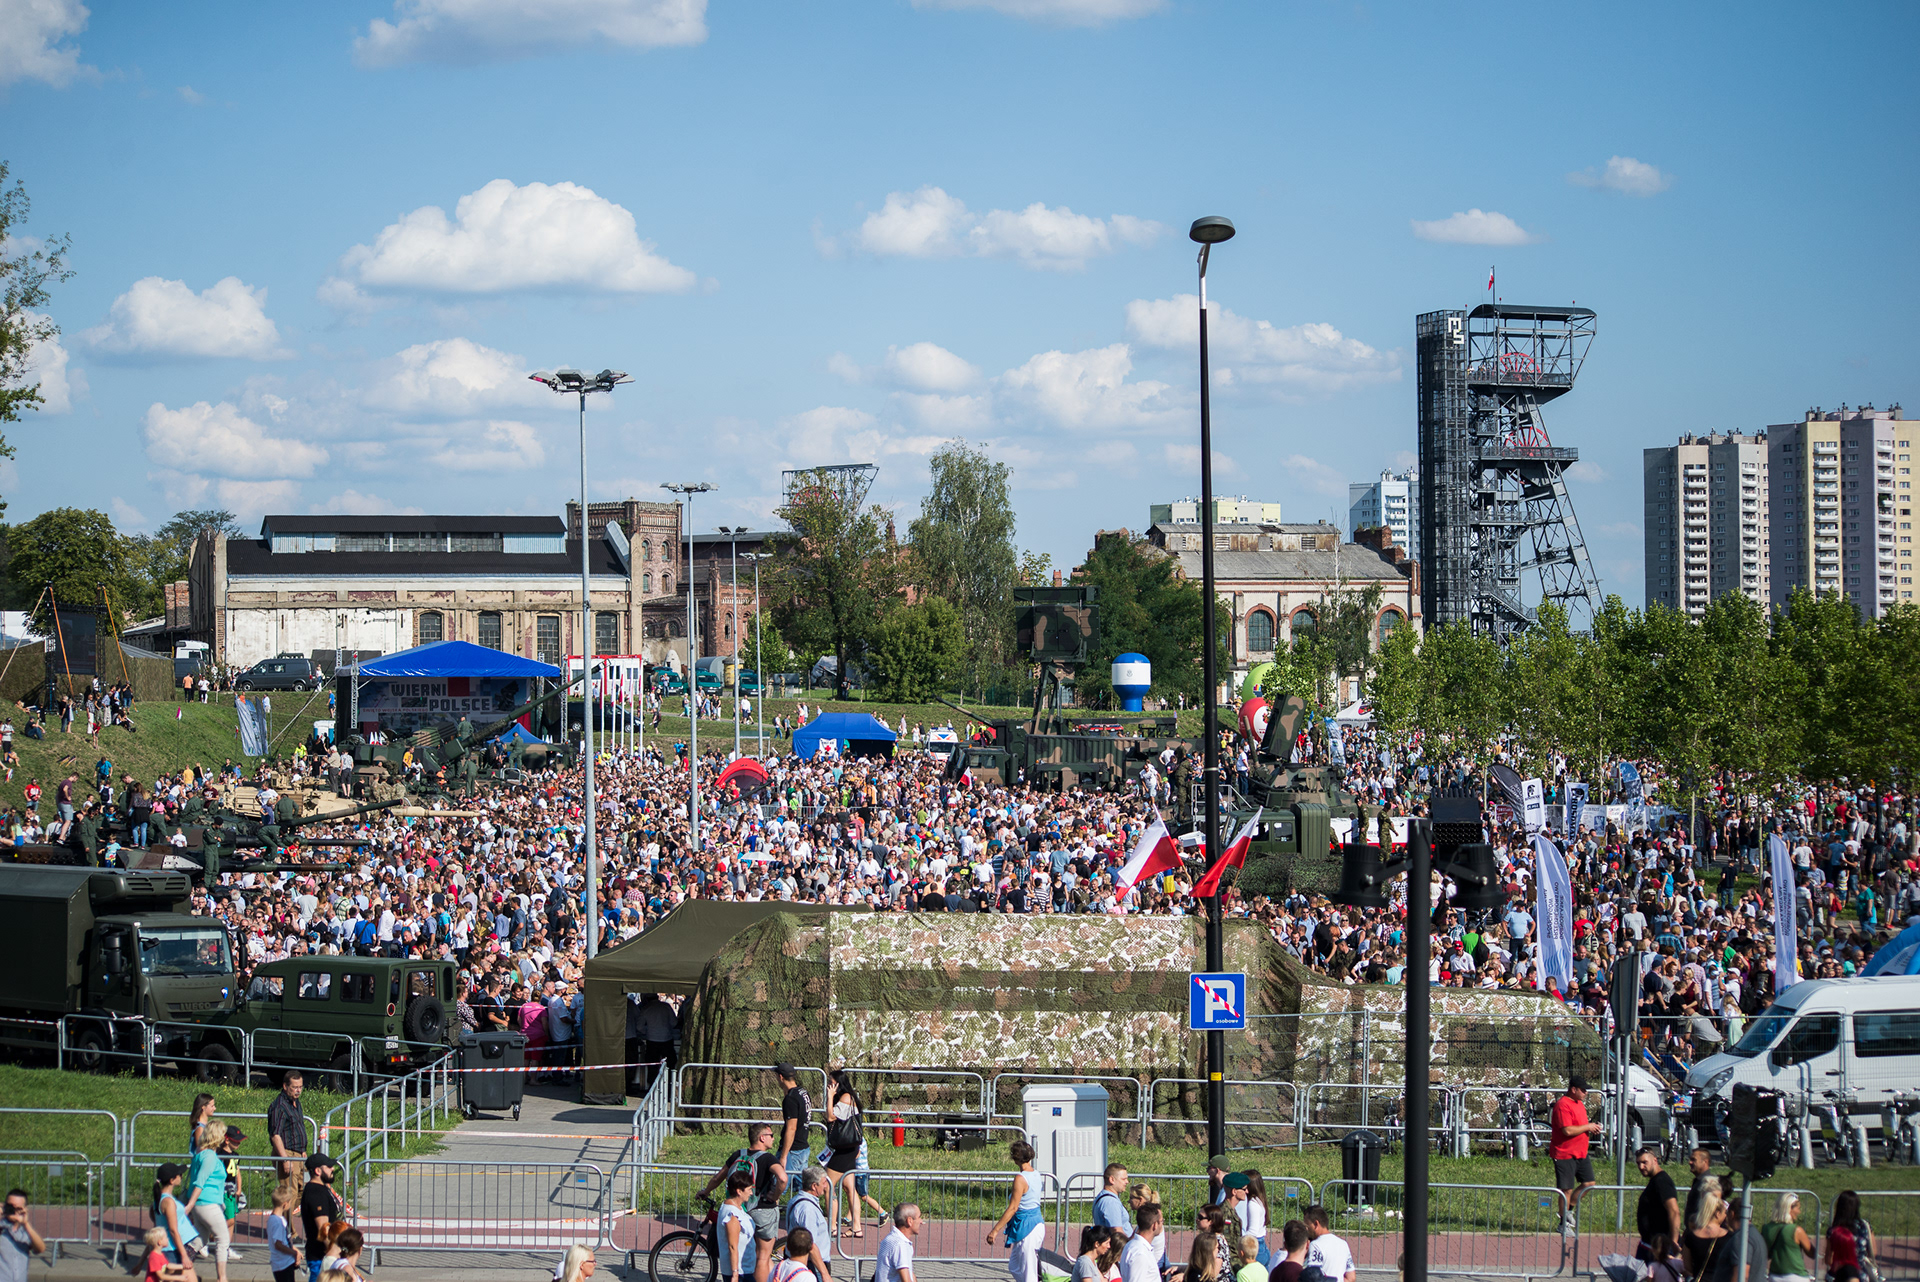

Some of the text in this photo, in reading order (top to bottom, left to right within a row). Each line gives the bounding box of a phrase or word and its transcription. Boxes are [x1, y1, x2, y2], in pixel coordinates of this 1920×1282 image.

[391, 683, 447, 697] WIERNI
[429, 698, 490, 712] POLSCE
[180, 1002, 211, 1010] IVECO
[1205, 980, 1235, 1022] P
